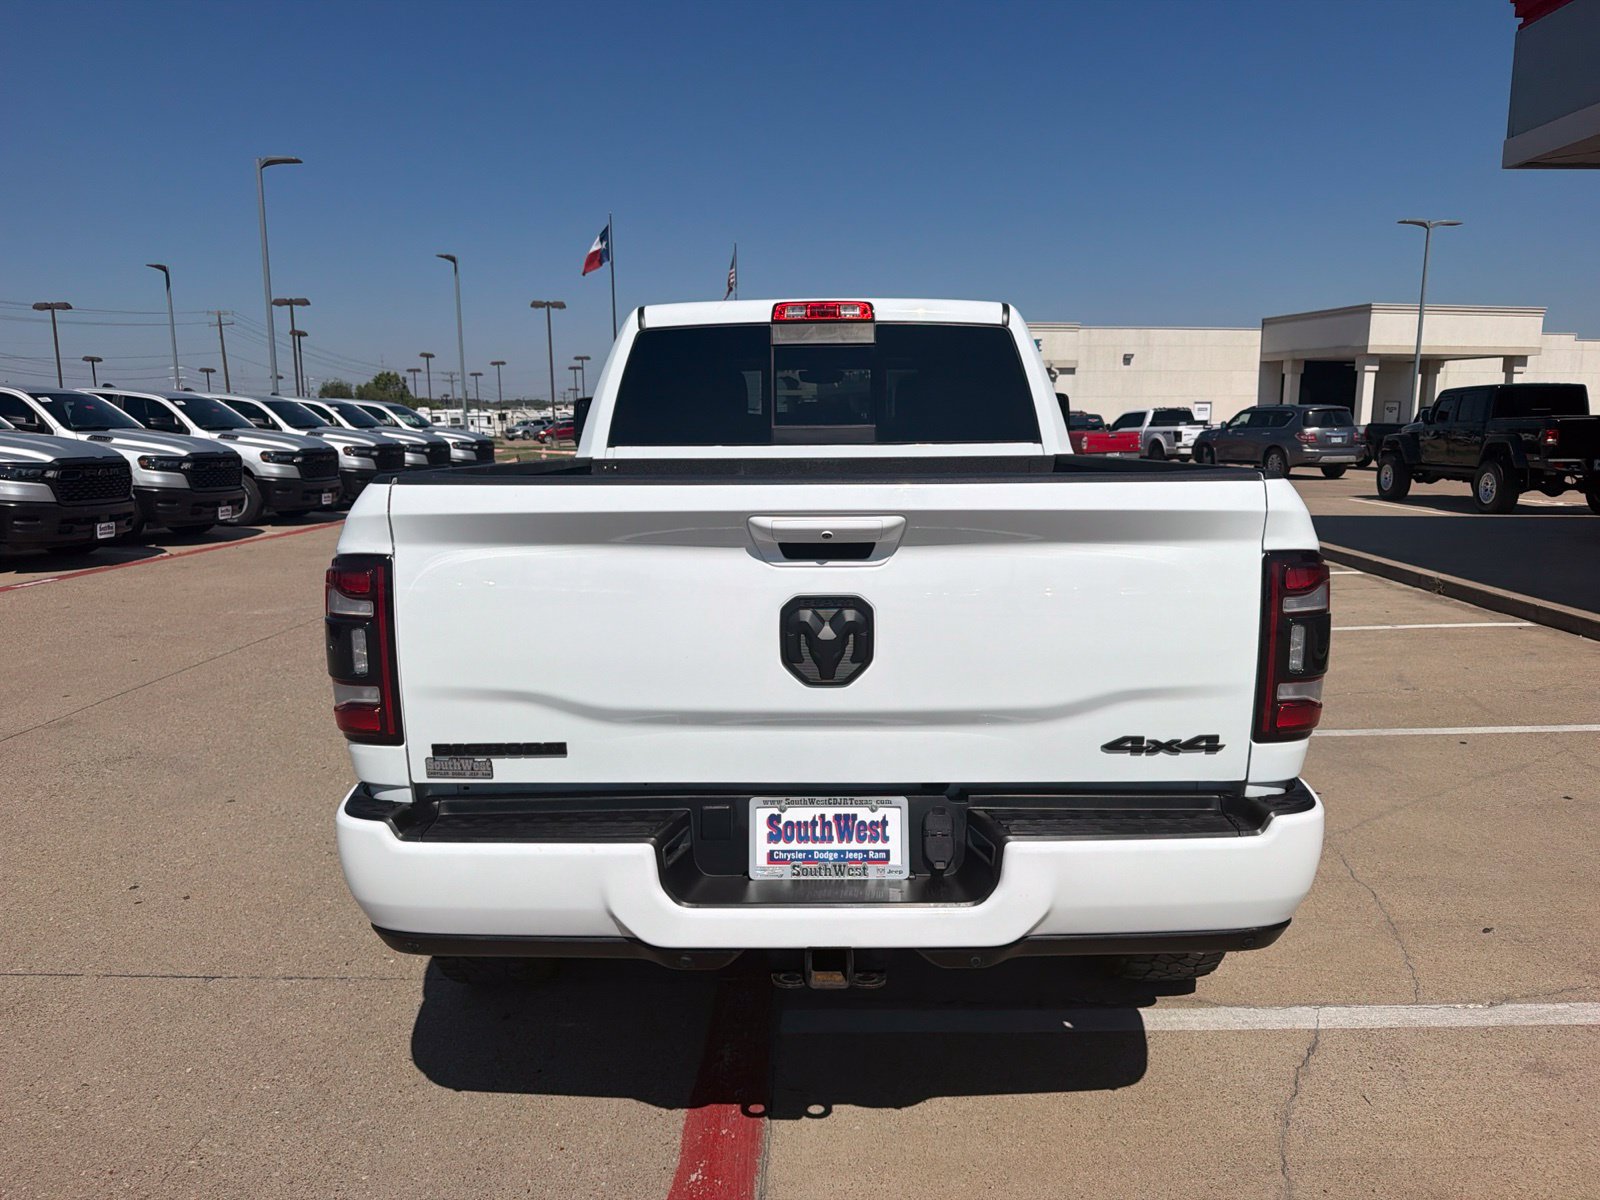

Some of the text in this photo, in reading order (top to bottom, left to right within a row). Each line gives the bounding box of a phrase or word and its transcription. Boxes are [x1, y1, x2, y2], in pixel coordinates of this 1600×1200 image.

[766, 813, 890, 844] SouthWest
[773, 850, 887, 861] Chrysler Dodge Jeep Ram
[790, 863, 870, 878] SouthWest
